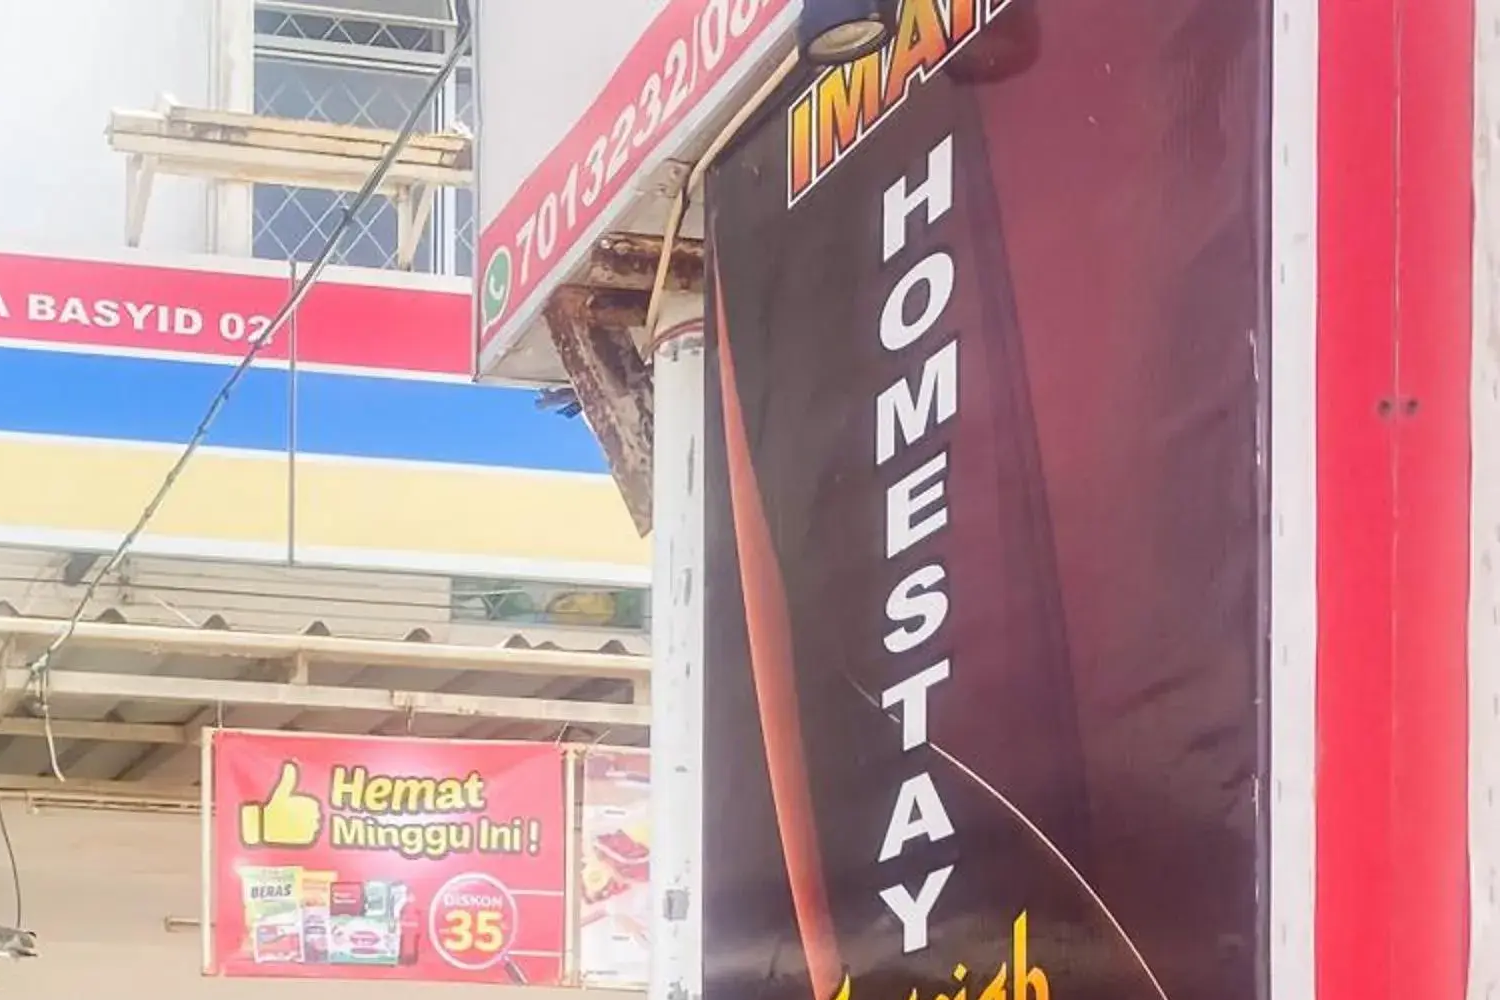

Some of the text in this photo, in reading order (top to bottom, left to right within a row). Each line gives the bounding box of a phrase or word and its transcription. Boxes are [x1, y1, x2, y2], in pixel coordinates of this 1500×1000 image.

[788, 0, 1012, 210] IMA
[28, 293, 202, 336] BASYID
[219, 312, 274, 346] 02
[877, 132, 958, 952] HOMESTAY
[332, 767, 485, 812] Hemat
[332, 817, 471, 859] Minggu
[250, 884, 292, 899] BERAS
